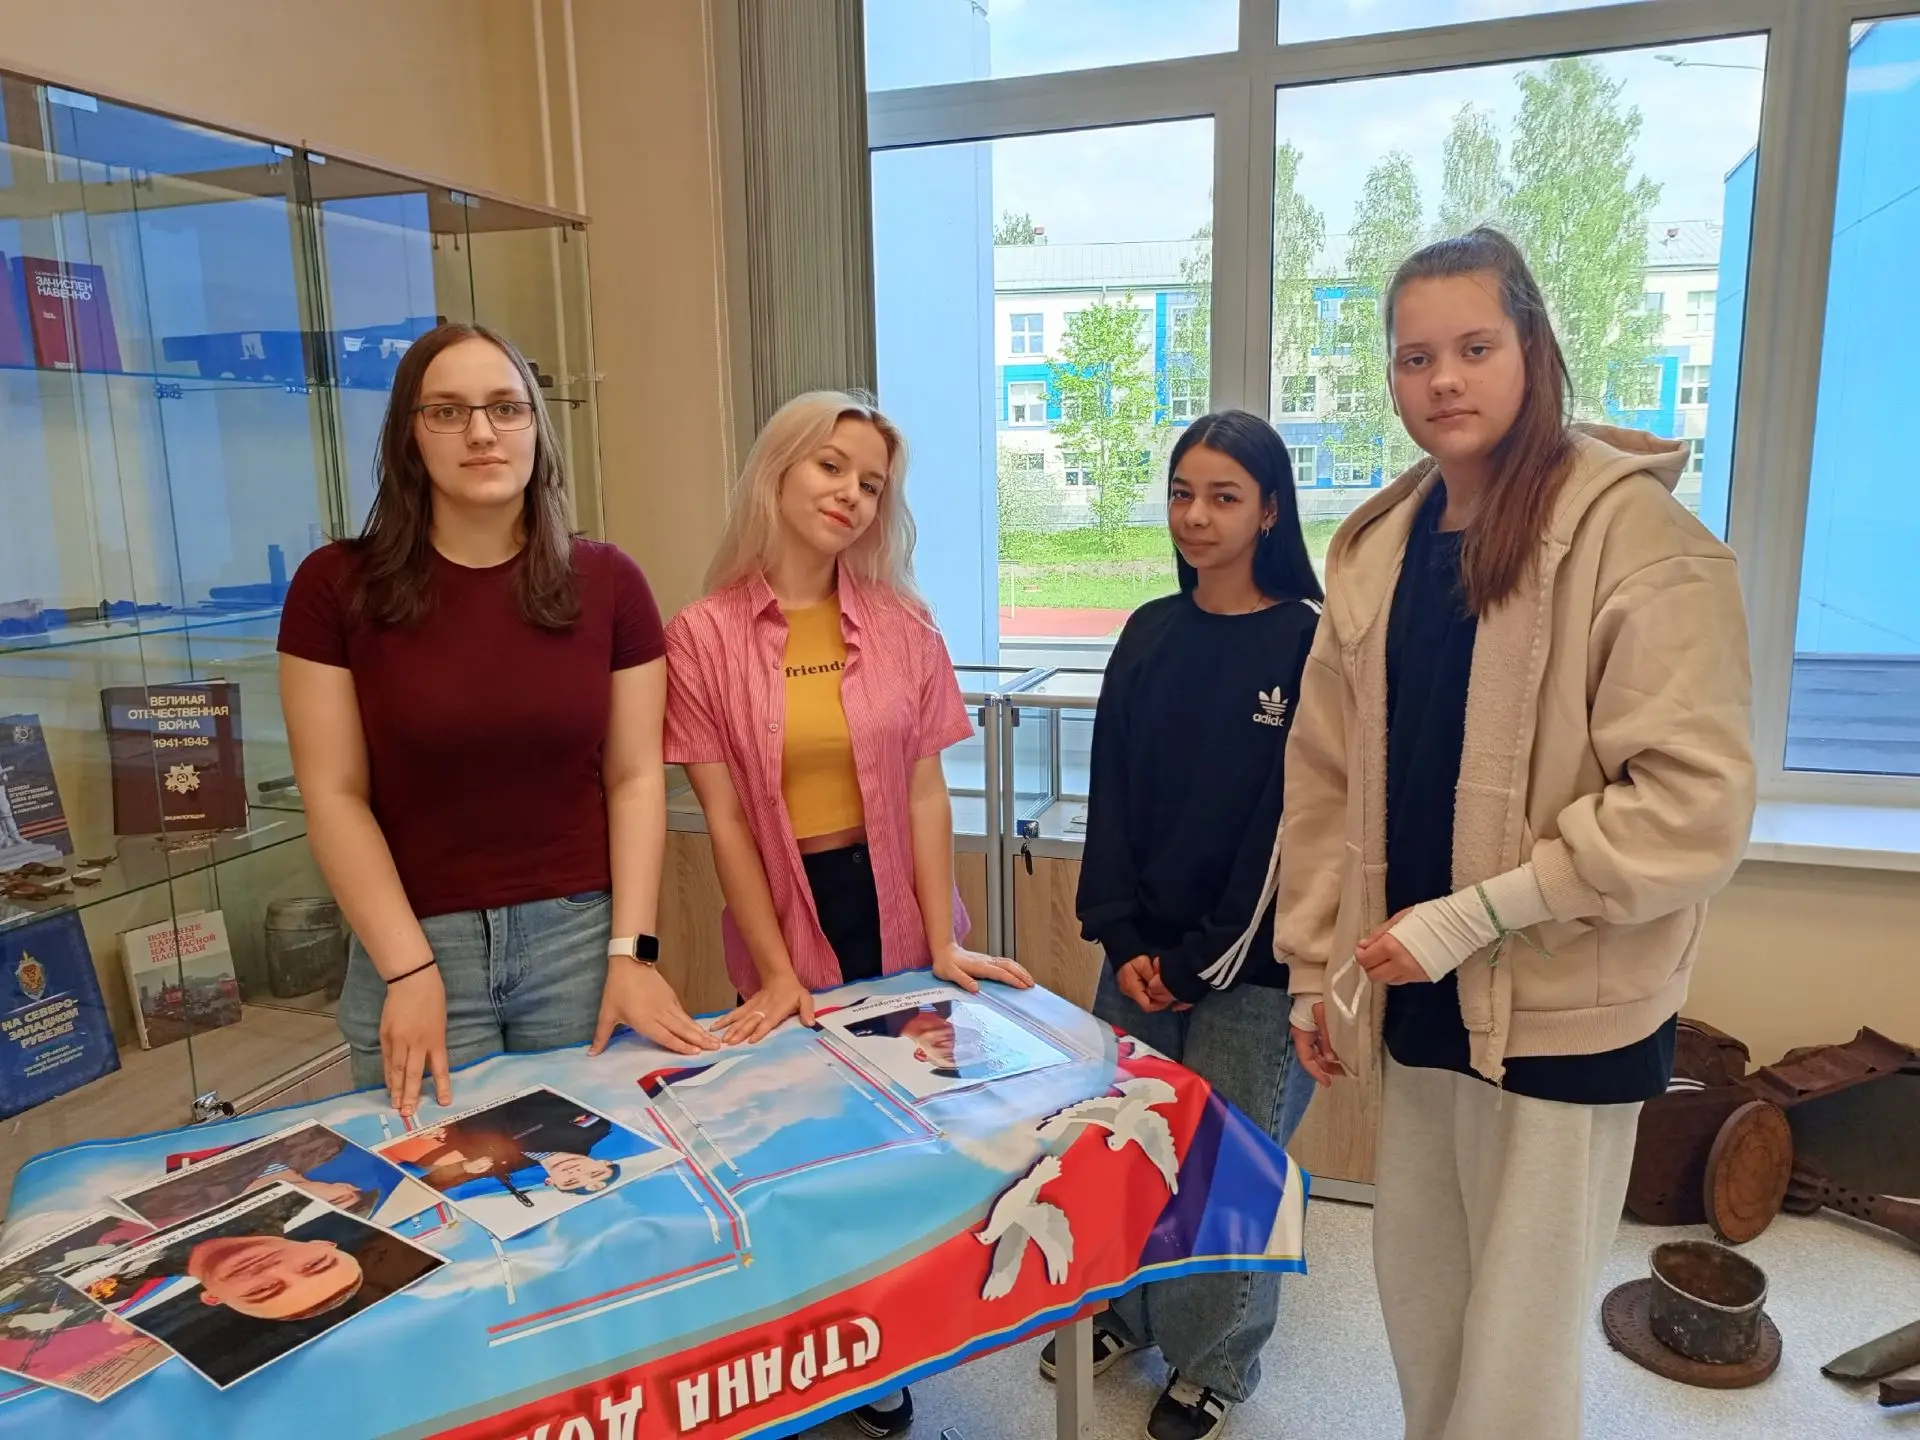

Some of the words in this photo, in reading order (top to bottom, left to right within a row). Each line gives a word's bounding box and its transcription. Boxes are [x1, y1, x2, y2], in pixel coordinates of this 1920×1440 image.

[35, 275, 93, 292] ЗАЧИСЛЕН
[37, 286, 91, 300] НАВЕЧНО
[150, 694, 206, 706] ВЕЛИКАЯ
[128, 706, 229, 719] ОТЕЧЕСТВЕННАЯ
[158, 719, 200, 730] ВОЙНА
[153, 736, 209, 748] 1941-1945
[150, 946, 166, 956] НА
[1, 1017, 23, 1032] НА
[23, 998, 79, 1022] СЕВЕРО-
[8, 1007, 79, 1041] ЗАПАДНОМ
[20, 1020, 75, 1049] РУБЕЖЕ
[676, 1316, 882, 1432] СТРАНА
